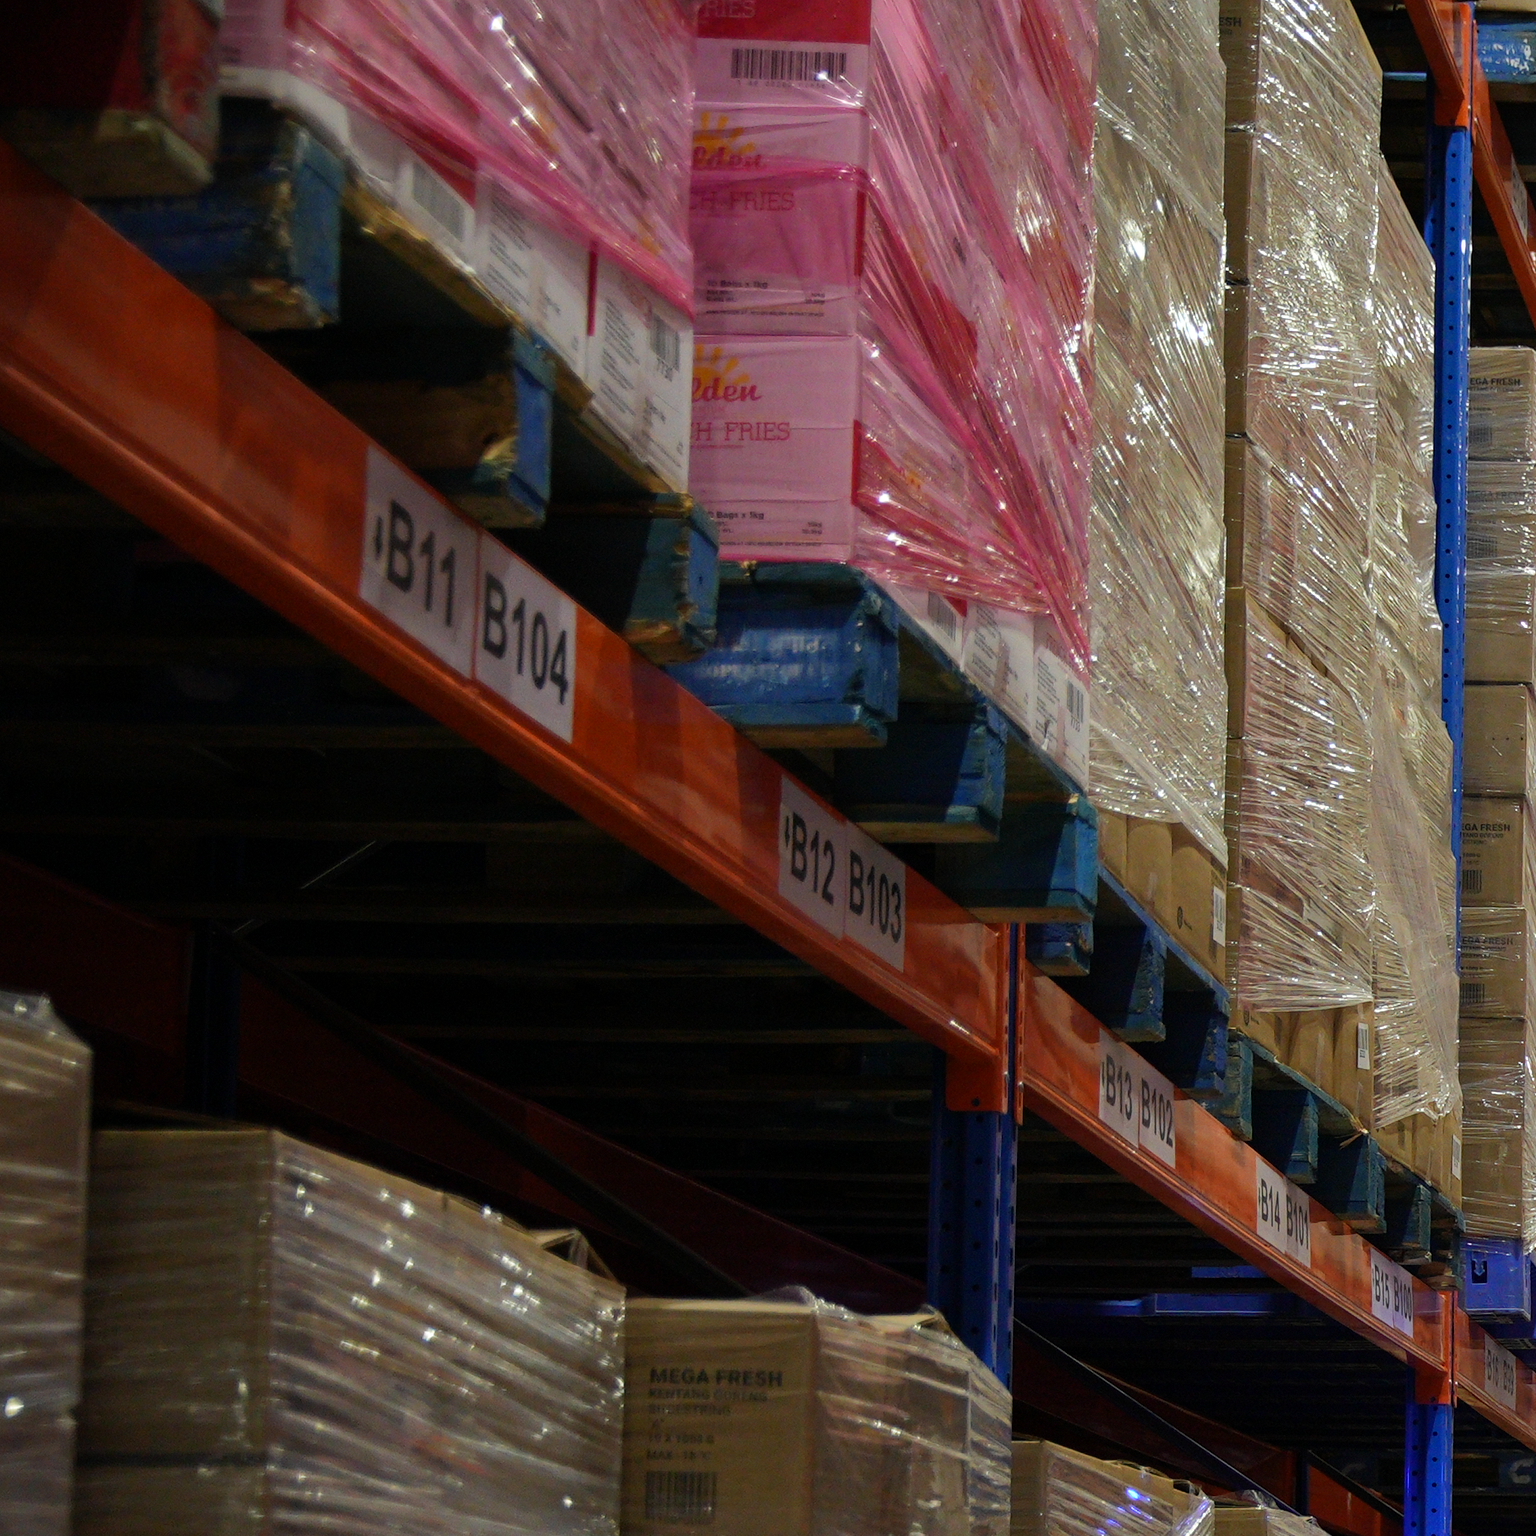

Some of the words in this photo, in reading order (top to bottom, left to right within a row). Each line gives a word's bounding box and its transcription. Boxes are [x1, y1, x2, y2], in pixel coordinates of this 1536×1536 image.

[1491, 378, 1521, 387] FRESH
[725, 421, 791, 442] FRIES
[716, 511, 739, 520] Bags
[387, 499, 457, 629] B11
[483, 571, 569, 706] B104
[1480, 823, 1511, 832] FRESH
[791, 812, 835, 907] B12
[849, 849, 902, 945] B103
[1106, 1053, 1133, 1121] B13
[1141, 1077, 1174, 1148] B102
[1261, 1178, 1281, 1233] B14
[1286, 1194, 1309, 1250] B101
[1374, 1264, 1390, 1310] B15
[650, 1367, 710, 1385] MEGA
[715, 1368, 784, 1388] FRESH
